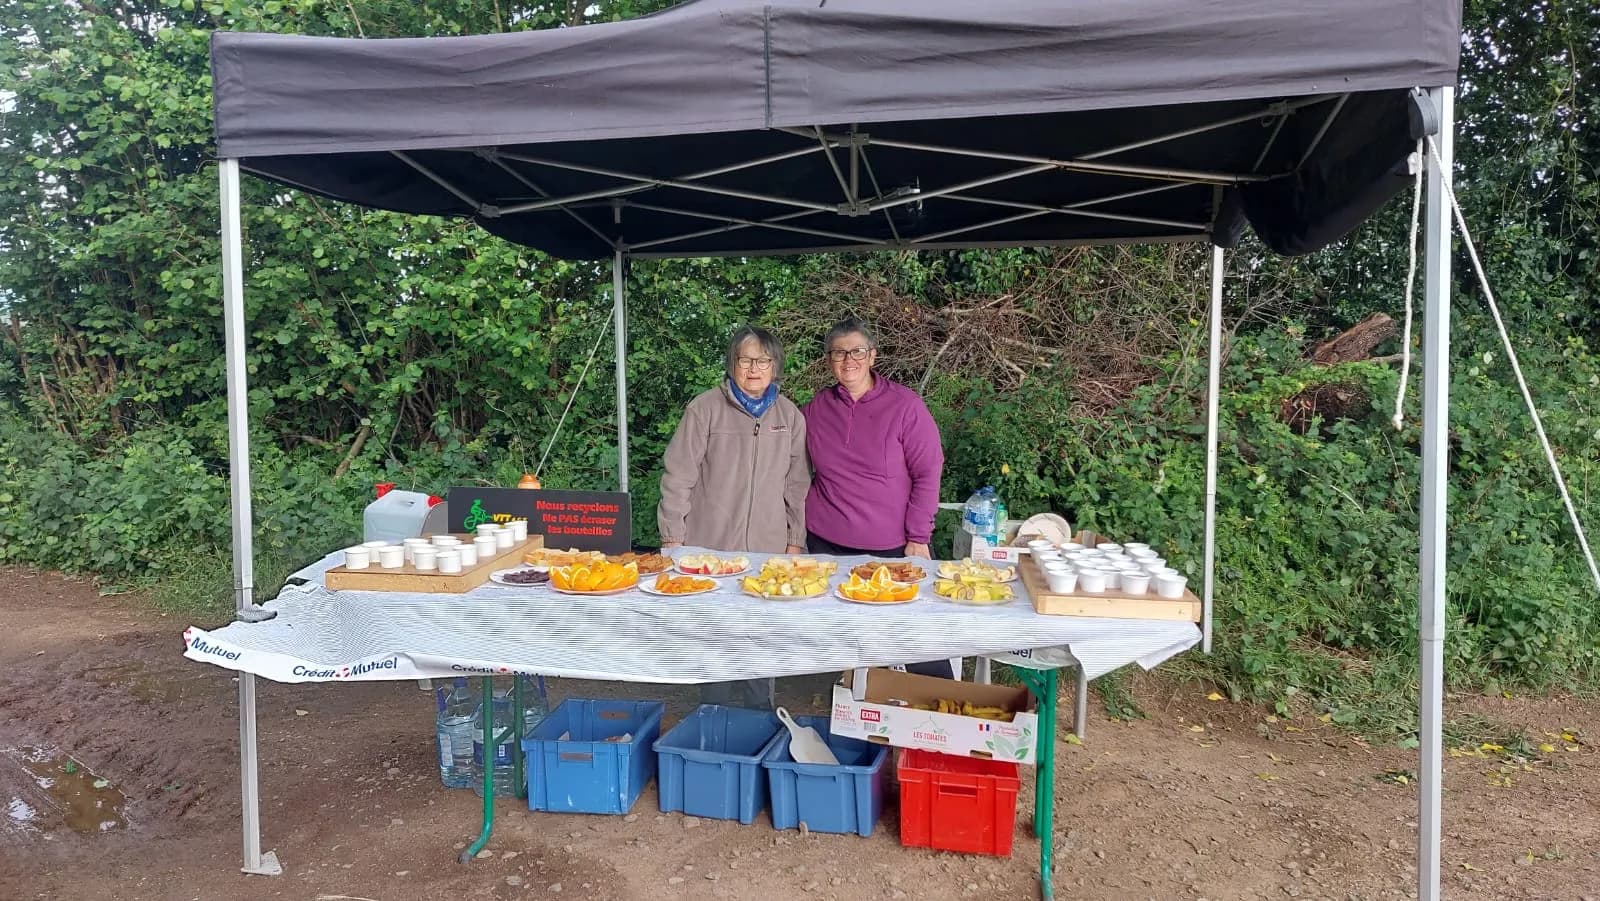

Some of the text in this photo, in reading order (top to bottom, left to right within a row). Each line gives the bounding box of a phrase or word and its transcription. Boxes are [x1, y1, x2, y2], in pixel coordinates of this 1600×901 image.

[536, 500, 619, 514] Nous recyclons
[542, 513, 617, 525] Ne PAS écraser
[547, 524, 613, 536] les bouteilles
[190, 636, 242, 661] Mutuel
[292, 656, 397, 678] Crédit Mutuel
[451, 664, 494, 673] Crédit
[862, 711, 879, 720] EXTRA
